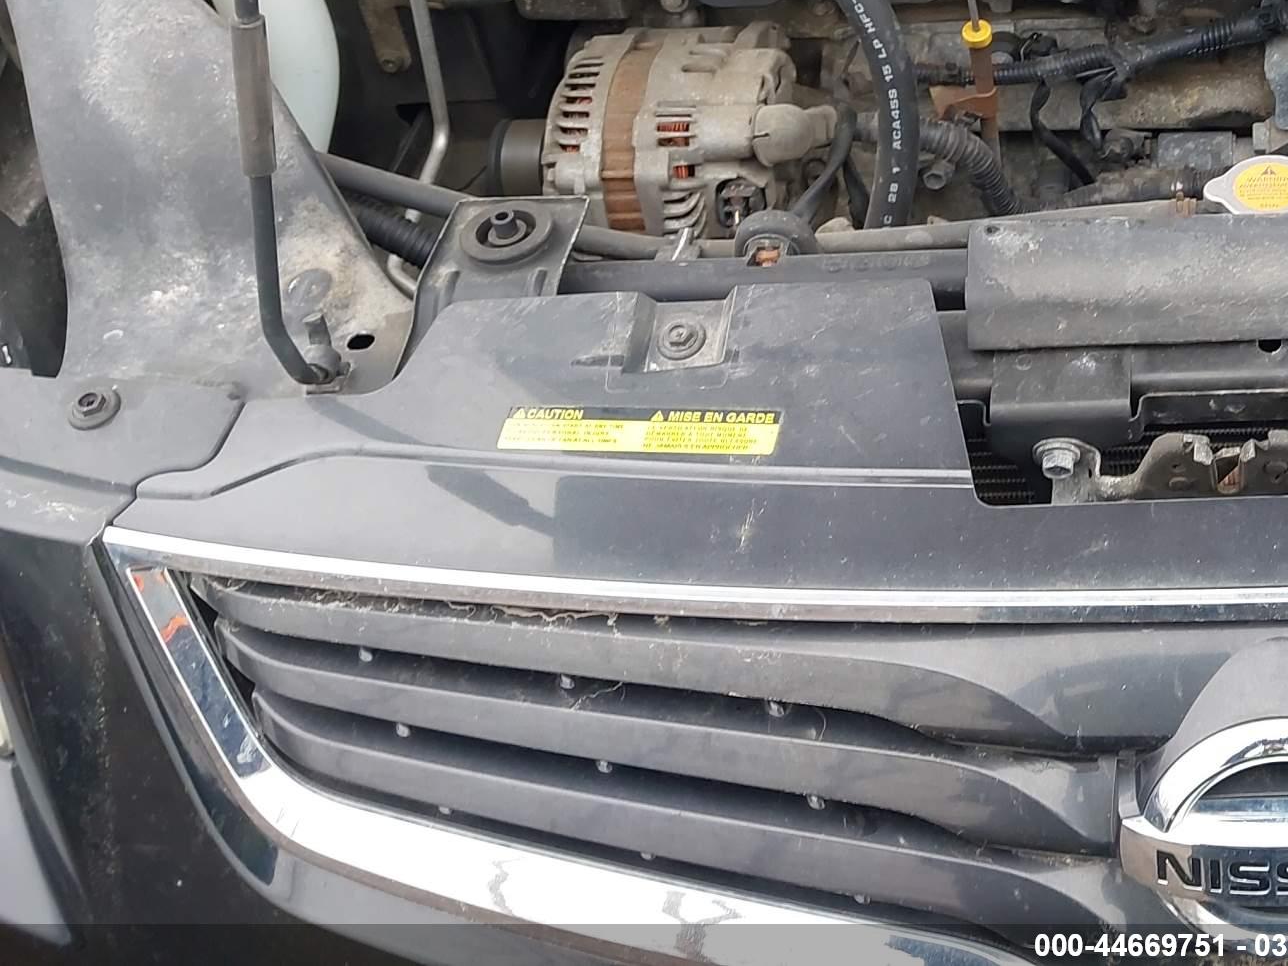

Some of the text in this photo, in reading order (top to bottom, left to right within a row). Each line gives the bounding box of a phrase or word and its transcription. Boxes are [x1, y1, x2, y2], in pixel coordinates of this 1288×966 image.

[873, 38, 888, 59] LP
[882, 64, 894, 83] 15
[527, 408, 584, 420] CAUTION
[667, 411, 776, 424] MISE EN GARDE
